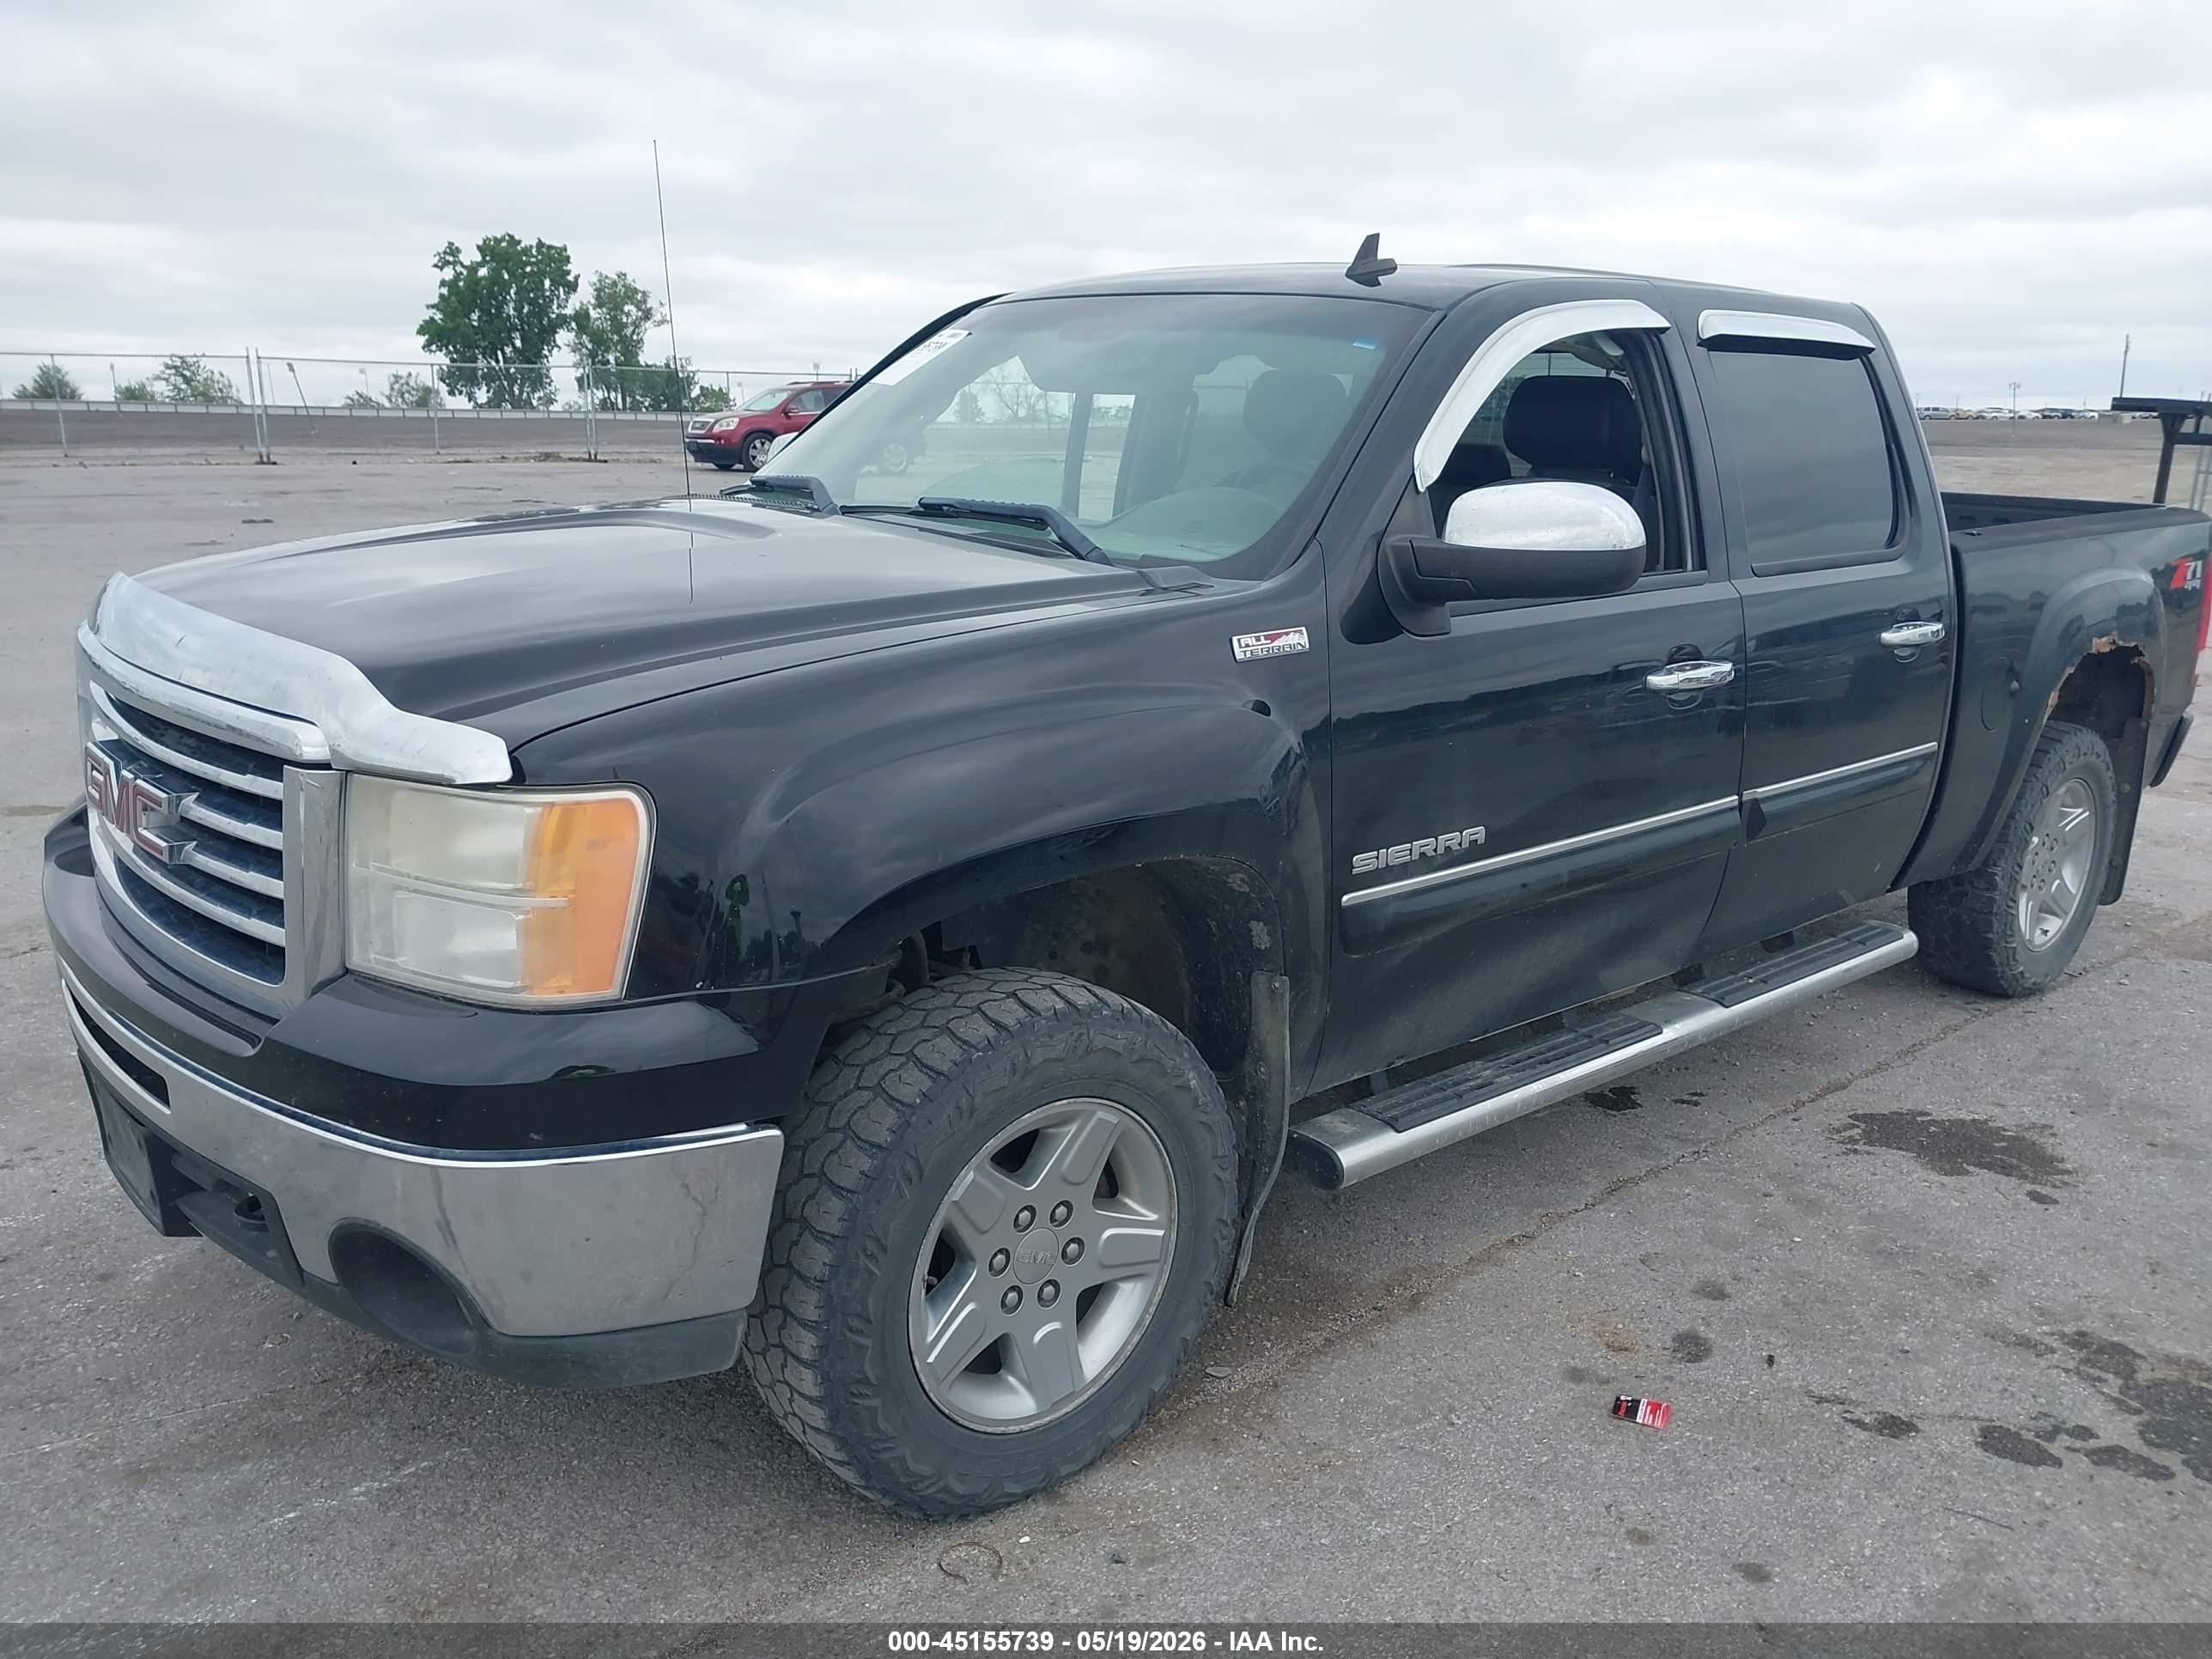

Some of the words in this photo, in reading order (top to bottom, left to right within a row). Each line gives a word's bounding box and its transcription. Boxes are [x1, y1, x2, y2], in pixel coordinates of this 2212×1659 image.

[1239, 641, 1307, 658] TERRAIN
[1240, 635, 1272, 647] ALL
[84, 741, 170, 864] GMC
[1352, 825, 1486, 876] SIERRA
